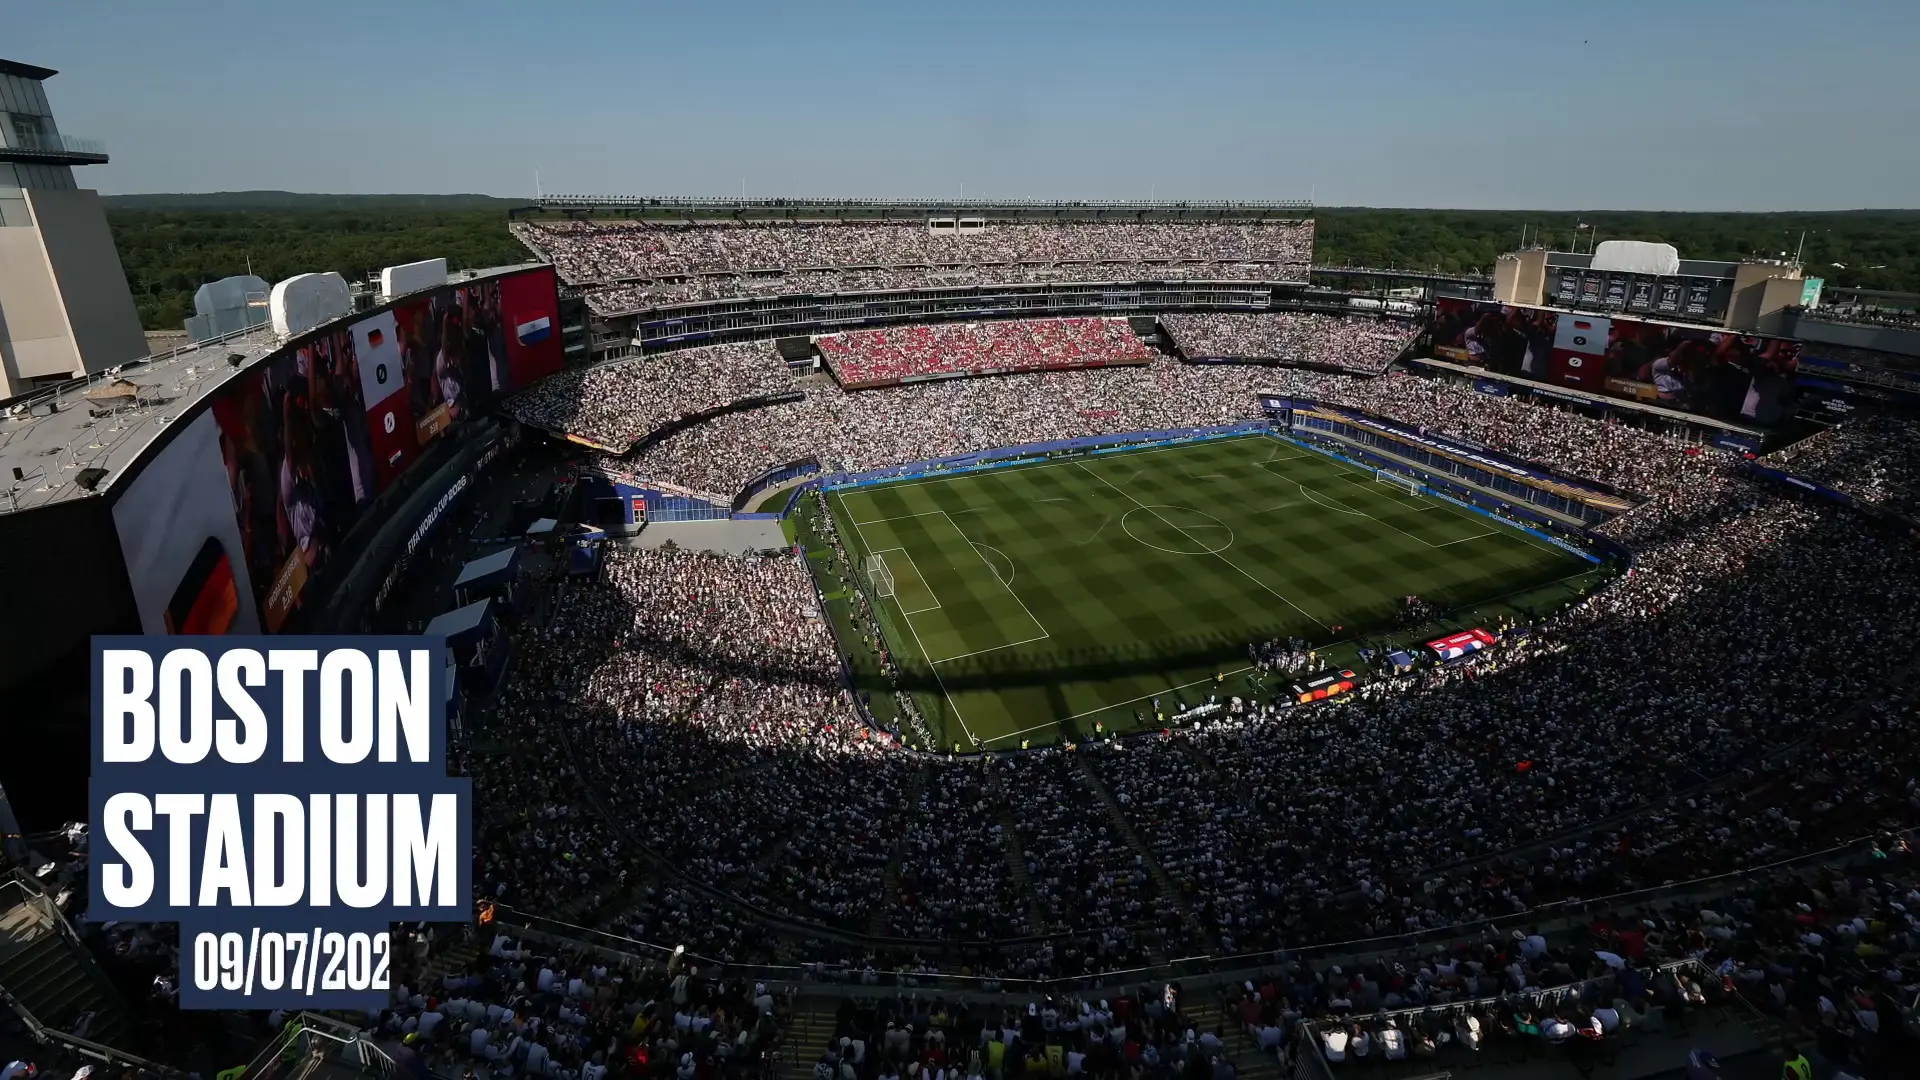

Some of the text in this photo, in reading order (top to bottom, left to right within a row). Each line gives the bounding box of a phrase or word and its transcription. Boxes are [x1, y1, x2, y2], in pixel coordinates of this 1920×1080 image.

[1574, 336, 1586, 345] 0
[1568, 357, 1582, 367] 0
[377, 364, 387, 384] 0
[384, 412, 395, 433] 0
[1358, 420, 1528, 475] FIFA WORLD CUP 2026
[828, 482, 858, 491] POWERADE
[877, 476, 906, 484] POWERADE
[1436, 492, 1468, 508] POWERADE
[408, 475, 466, 554] FIFA WORLD CUP 2026
[1488, 512, 1526, 531] POWERADE
[1548, 537, 1588, 557] POWERADE
[1308, 676, 1334, 687] GERMANY
